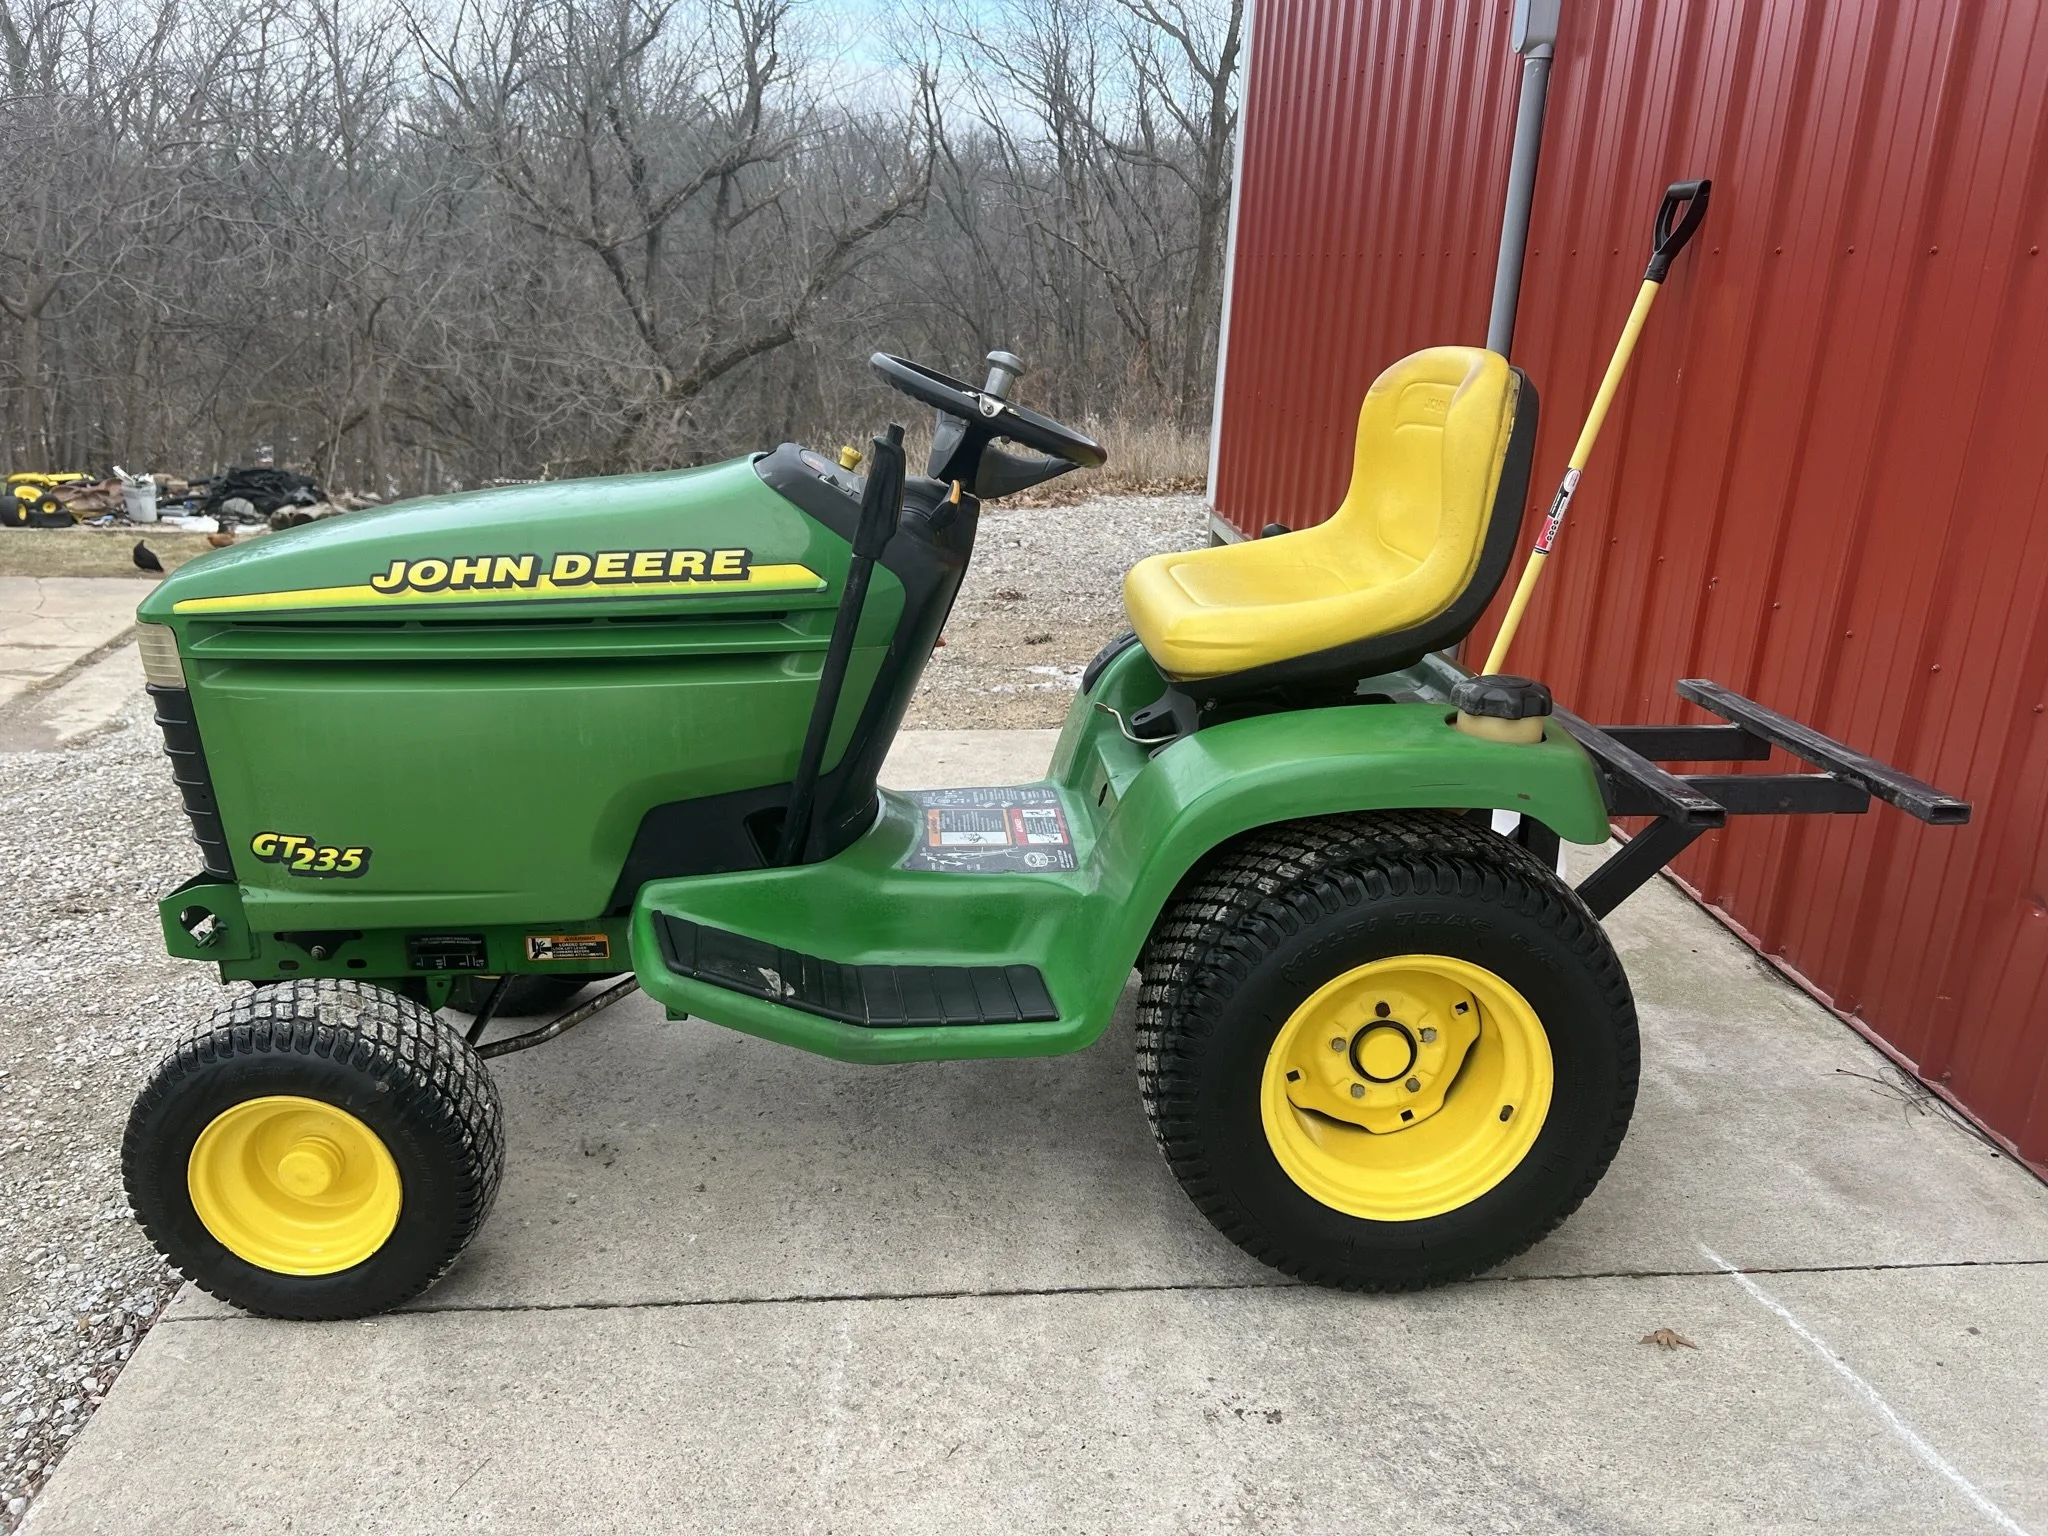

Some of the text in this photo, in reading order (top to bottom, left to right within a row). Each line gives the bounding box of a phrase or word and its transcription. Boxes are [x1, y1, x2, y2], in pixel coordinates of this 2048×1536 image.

[371, 548, 752, 594] JOHN DEERE
[1280, 915, 1379, 986] MULTI
